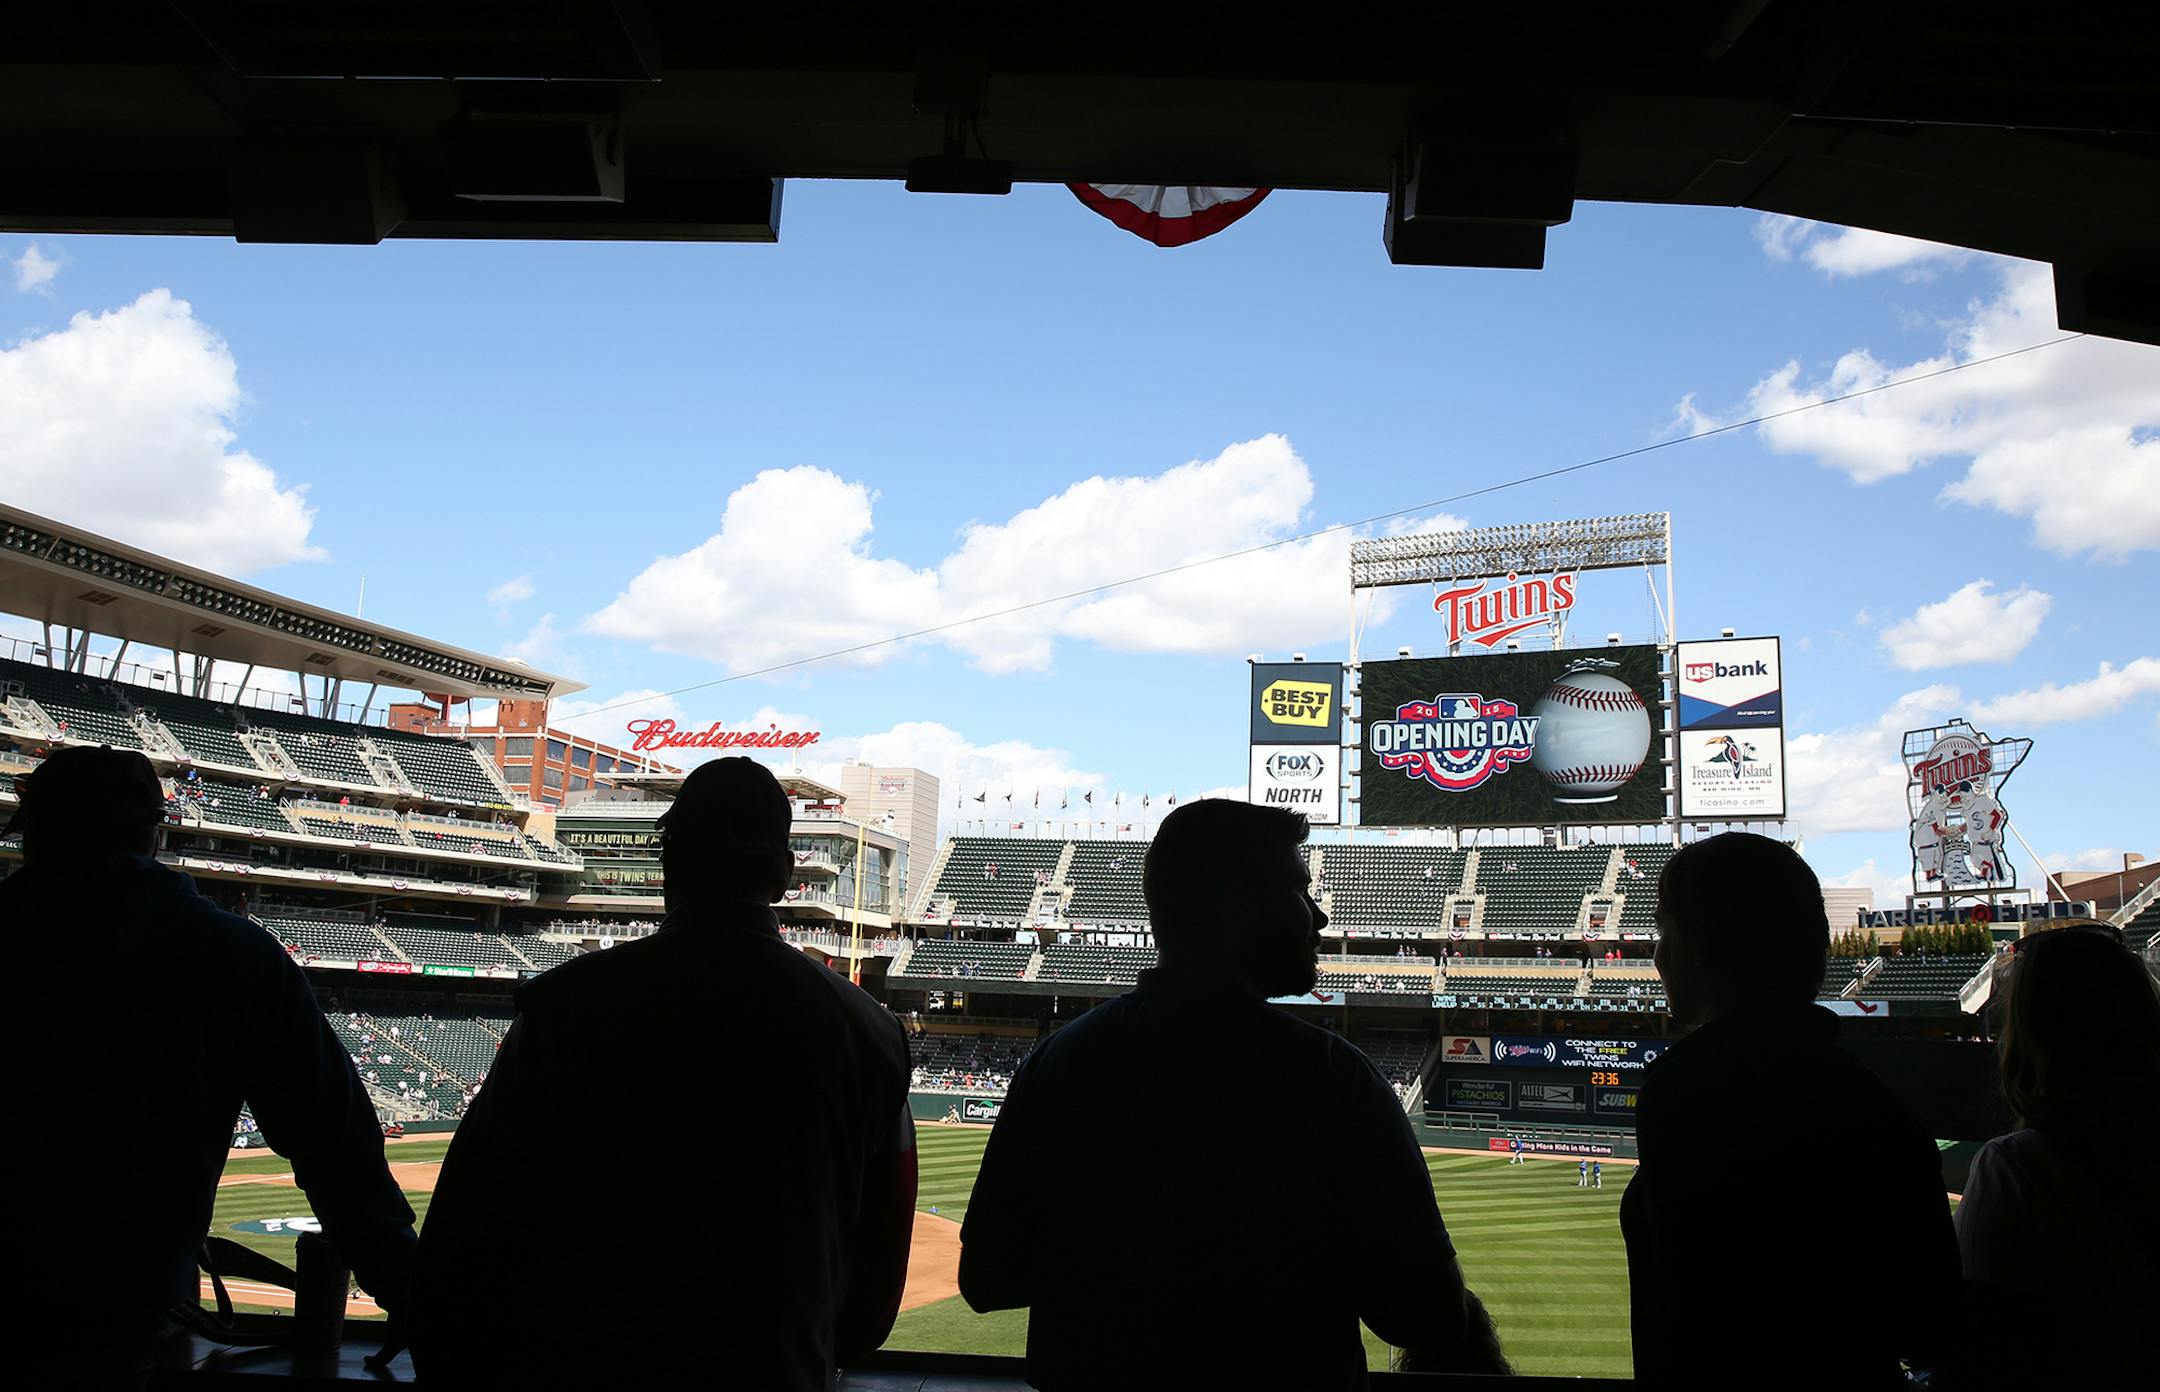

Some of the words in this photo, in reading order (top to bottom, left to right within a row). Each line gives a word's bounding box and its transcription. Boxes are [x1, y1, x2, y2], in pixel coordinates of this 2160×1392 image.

[1433, 570, 1577, 648] Twins
[1271, 688, 1328, 705] BEST
[1272, 703, 1323, 719] BUY
[1416, 705, 1433, 716] 20
[1485, 705, 1500, 715] 15
[627, 718, 821, 750] Budweiser
[1373, 721, 1487, 752] OPENING
[1492, 720, 1537, 746] DAY
[1278, 755, 1311, 770] FOX
[1691, 765, 1732, 779] Treasure
[1742, 765, 1773, 778] Island
[1913, 748, 1992, 798] Twins
[1265, 787, 1322, 803] NORTH
[1700, 798, 1765, 807] ticasino.com
[570, 834, 586, 843] IT'S
[587, 834, 593, 843] A
[593, 834, 634, 844] BEAUTIFUL
[634, 835, 649, 845] DAY
[596, 871, 611, 880] THIS
[612, 871, 618, 880] IS
[620, 871, 645, 883] TWINS
[647, 872, 664, 881] TERR
[1858, 907, 1966, 928] TARGET
[1998, 900, 2091, 922] FIELD
[1565, 1039, 1618, 1048] CONNECT
[1621, 1040, 1637, 1048] TO
[1599, 1047, 1628, 1055] FREE
[1587, 1060, 1645, 1069] NETWORK
[1462, 1082, 1495, 1090] Wonderful
[1591, 1072, 1619, 1086] 23:36
[1451, 1089, 1505, 1101] PISTACHIOS
[1520, 1084, 1544, 1097] ALTEC
[1598, 1093, 1639, 1108] SUBW
[1536, 1142, 1553, 1151] More
[1555, 1143, 1570, 1151] Kids
[1578, 1144, 1590, 1152] the
[1591, 1145, 1611, 1154] Game
